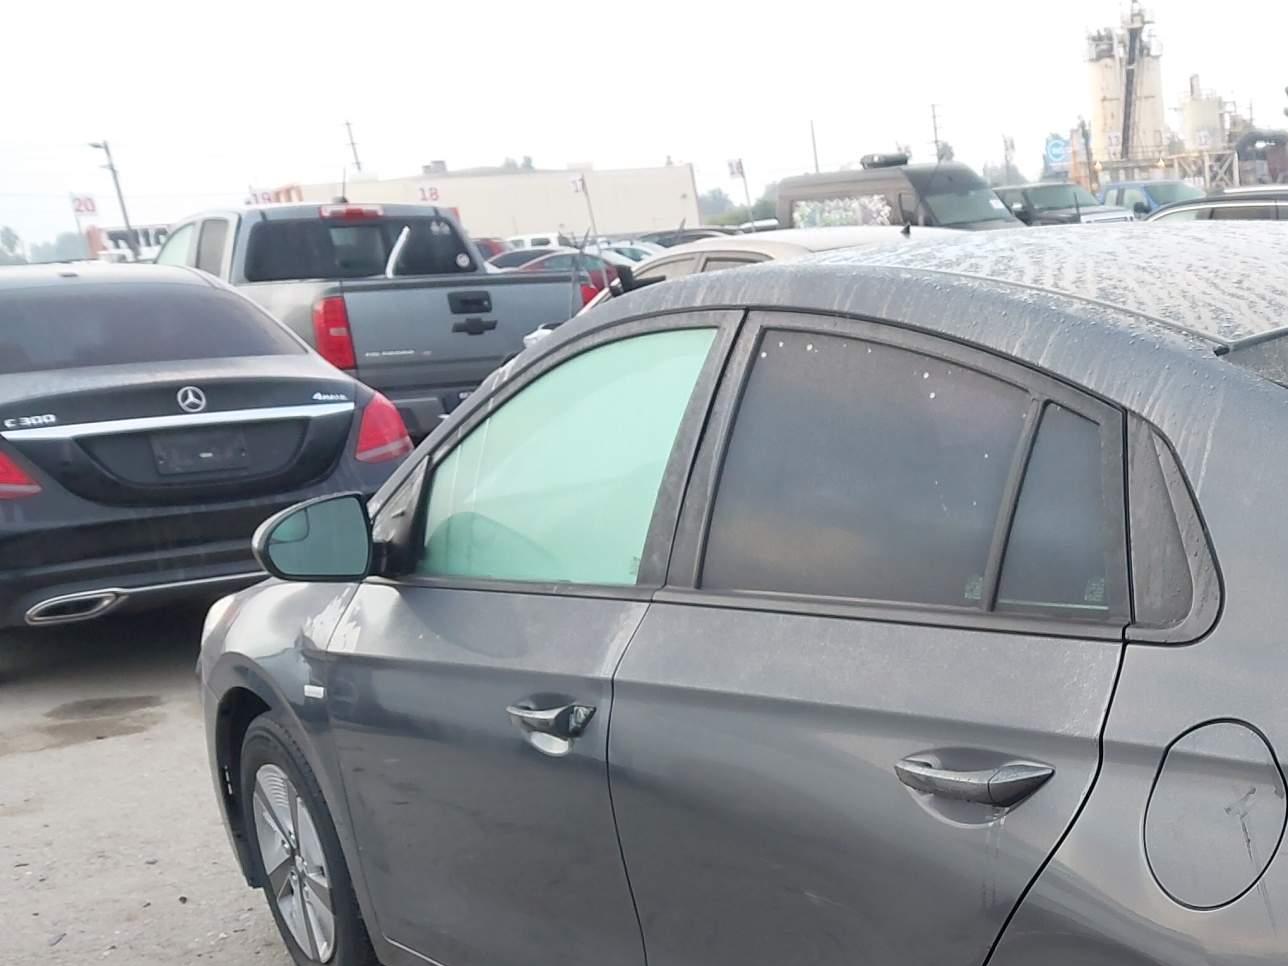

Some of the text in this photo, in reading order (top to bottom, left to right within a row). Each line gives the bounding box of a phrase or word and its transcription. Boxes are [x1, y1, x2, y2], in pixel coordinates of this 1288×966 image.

[418, 187, 440, 202] 18
[72, 197, 96, 213] 20
[18, 414, 57, 426] 300
